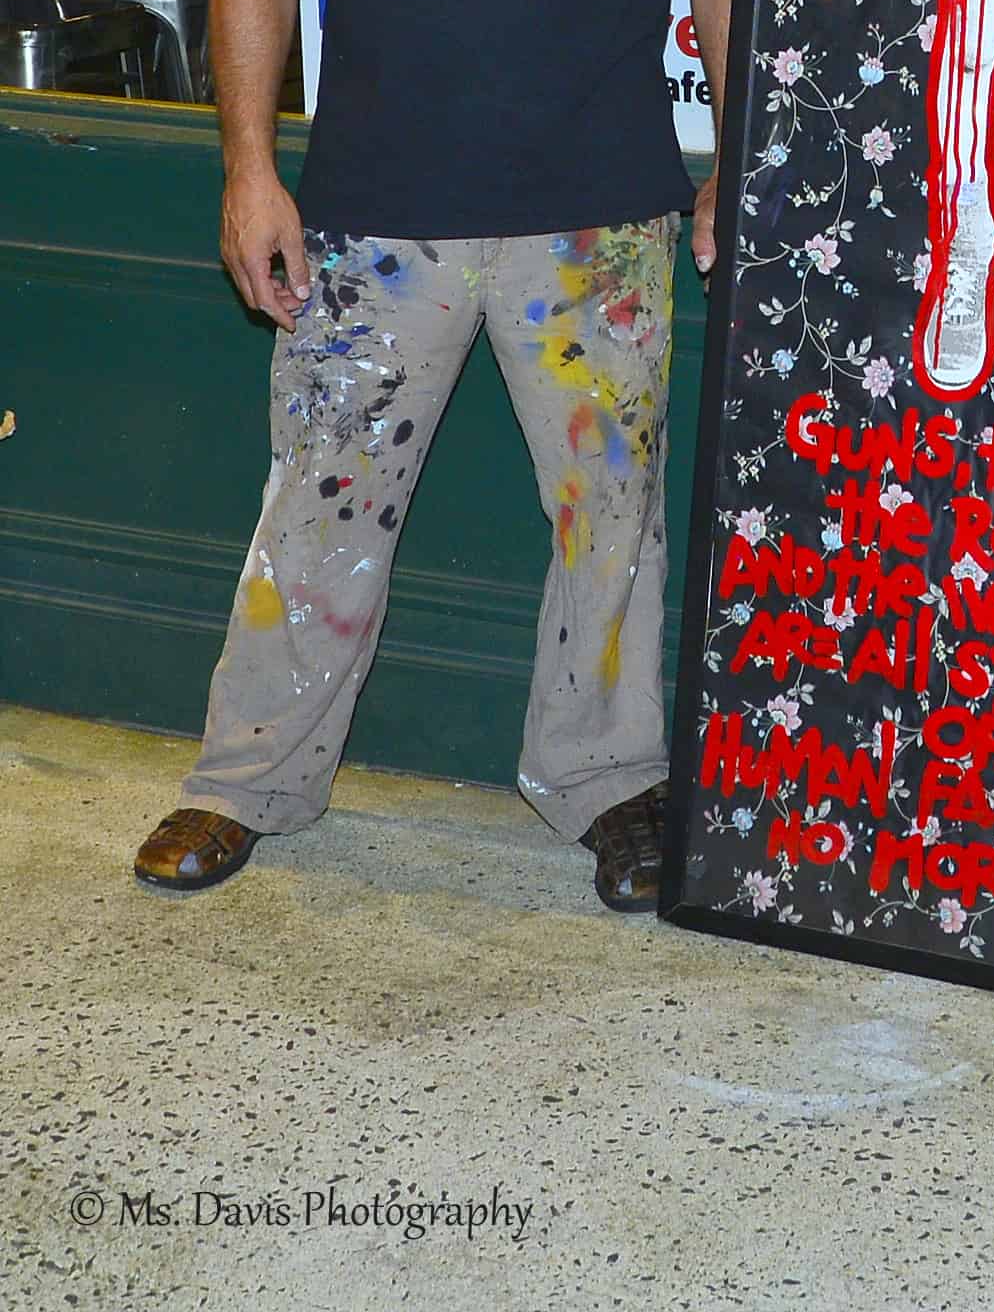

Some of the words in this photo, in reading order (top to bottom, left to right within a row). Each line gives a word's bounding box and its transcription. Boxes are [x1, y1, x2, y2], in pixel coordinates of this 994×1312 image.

[825, 479, 934, 557] the
[718, 533, 826, 600] AND
[828, 547, 927, 619] the
[730, 610, 843, 682] ARE
[767, 810, 846, 866] NO
